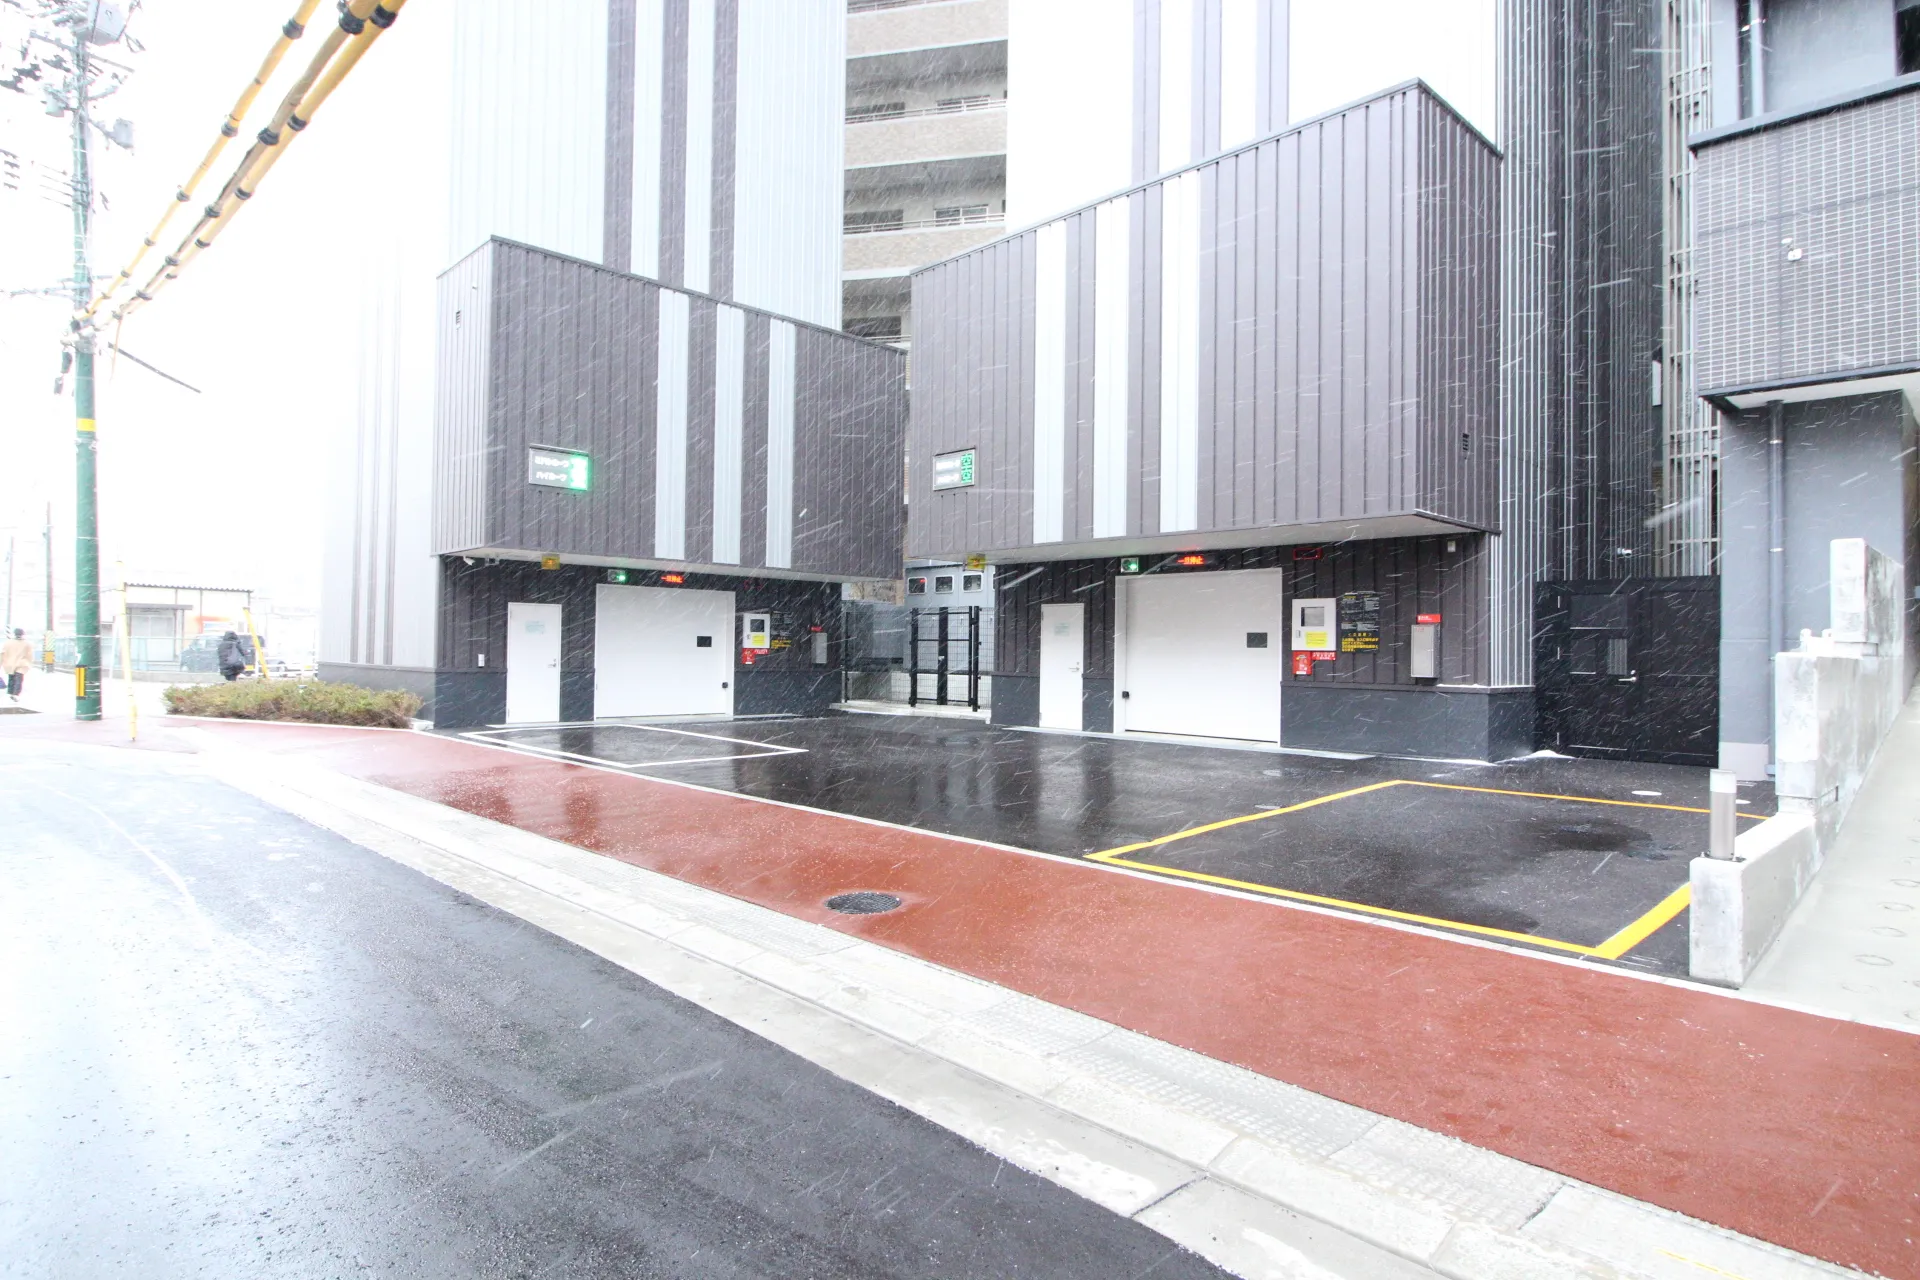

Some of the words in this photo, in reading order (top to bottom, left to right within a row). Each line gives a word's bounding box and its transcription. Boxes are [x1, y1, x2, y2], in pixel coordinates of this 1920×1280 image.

[536, 471, 567, 482] ハイルーフ
